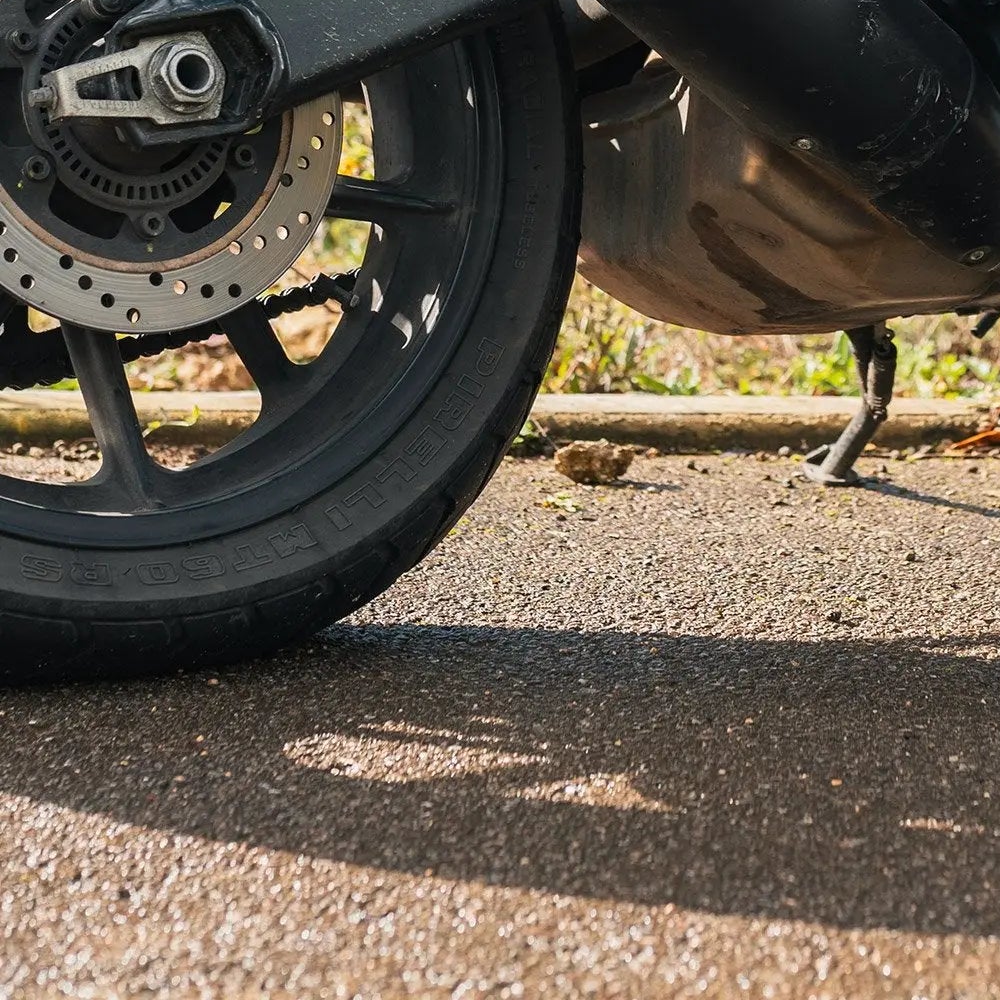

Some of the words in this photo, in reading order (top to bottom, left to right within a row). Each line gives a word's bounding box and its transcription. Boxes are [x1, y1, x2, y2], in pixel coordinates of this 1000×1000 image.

[323, 337, 506, 531] PIRELLI
[19, 555, 112, 585] RS
[137, 523, 318, 586] MT60
